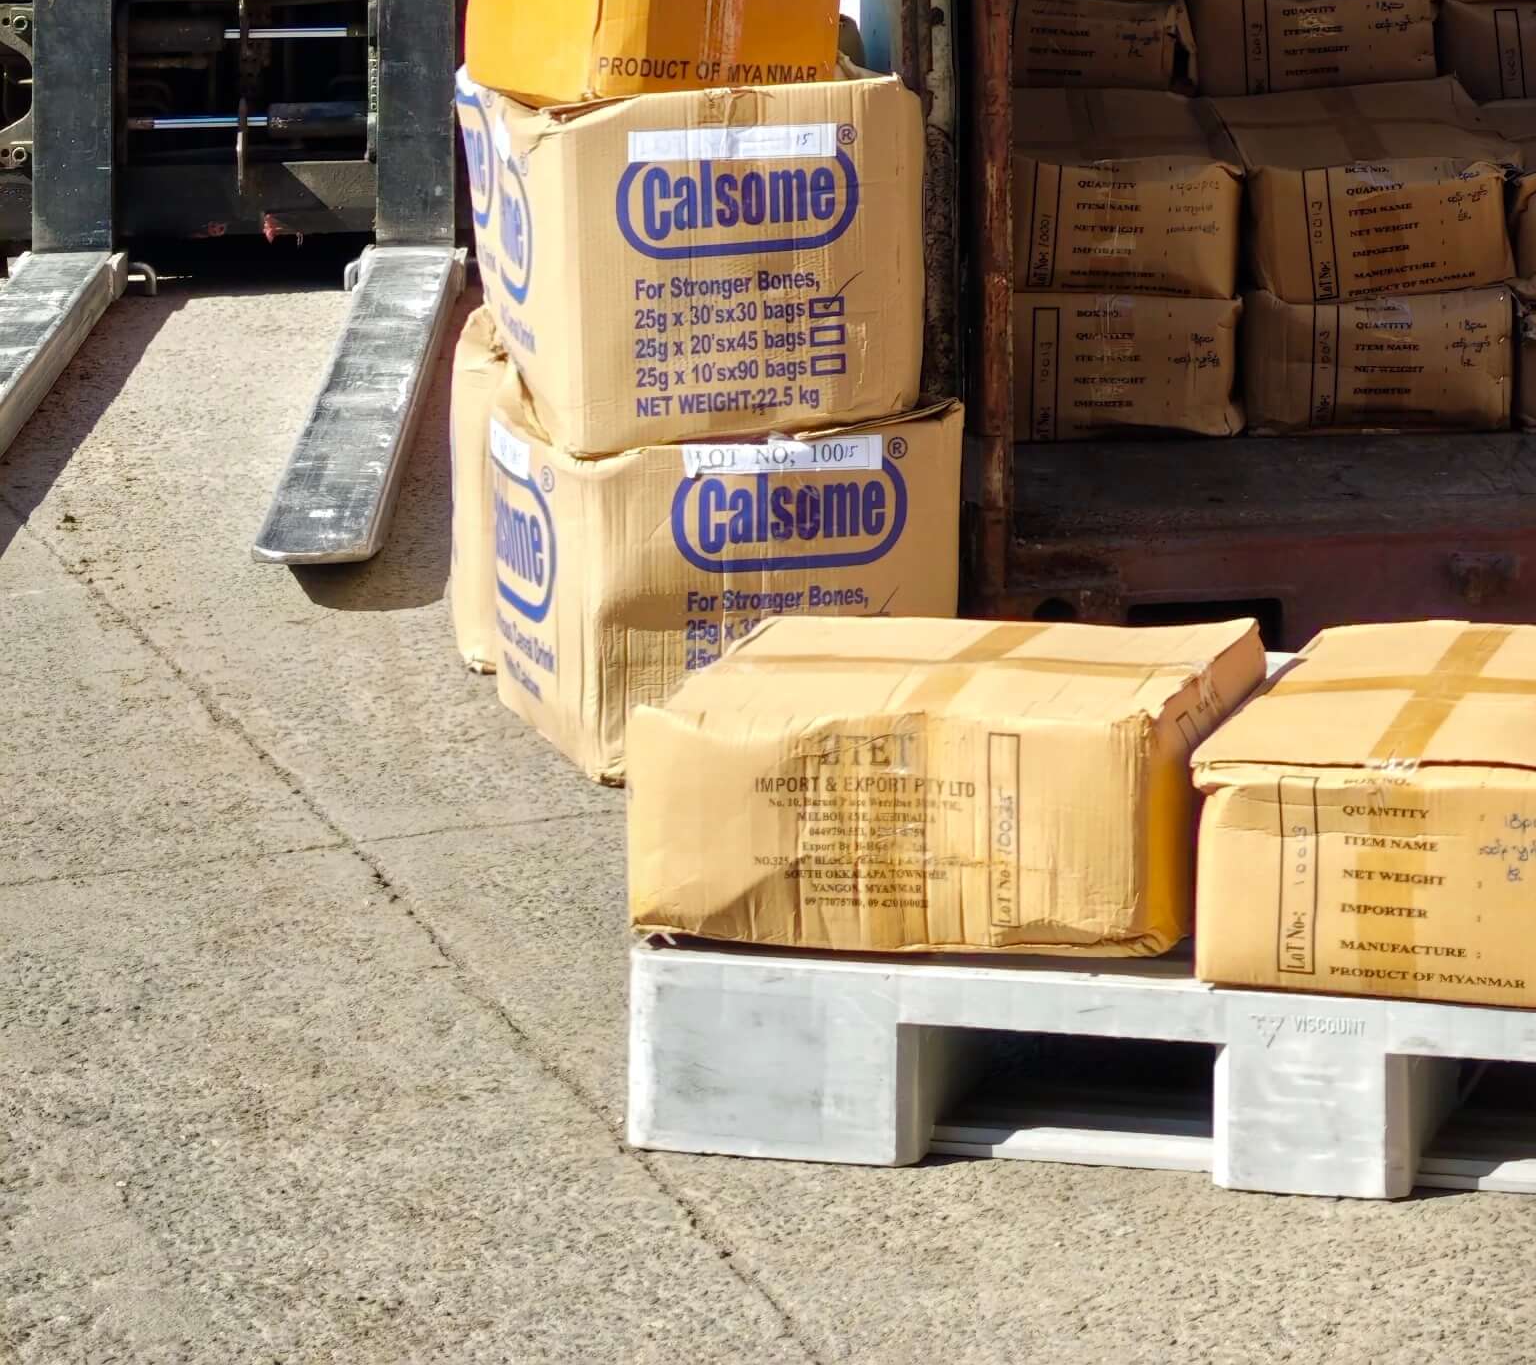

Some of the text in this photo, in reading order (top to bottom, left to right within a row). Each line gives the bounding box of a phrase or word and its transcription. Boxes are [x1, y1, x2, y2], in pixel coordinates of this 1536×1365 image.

[599, 56, 818, 83] PRODUCT OF MYANMAR
[642, 158, 836, 241] Calsome
[1349, 202, 1413, 217] ITEM NAME
[1350, 221, 1421, 238] NET WEIGHT
[634, 269, 821, 301] For Stronger Bones,
[634, 298, 807, 330] 25g x 30'sx30 bags
[634, 327, 807, 360] 25g x 20'sx45 bags
[635, 357, 808, 389] 25g x 10'sx90 bags
[636, 395, 673, 417] NET
[799, 383, 820, 409] kg
[755, 446, 796, 468] NO;
[697, 471, 887, 555] Calsome
[686, 586, 869, 613] For Stronger Bones,
[685, 618, 719, 643] 25g
[754, 776, 976, 798] IMPORT & EXPORT PTY LTD
[1342, 805, 1430, 820] QUANTITY
[1343, 834, 1439, 853] ITEM NAME
[1343, 868, 1447, 886] NET WEIGHT
[1340, 902, 1429, 920] IMPORTER
[1340, 939, 1467, 959] MANUFACTURE
[1329, 966, 1528, 990] PRODUCT OF MYANMAR
[1295, 1015, 1366, 1038] VISCOUNT
